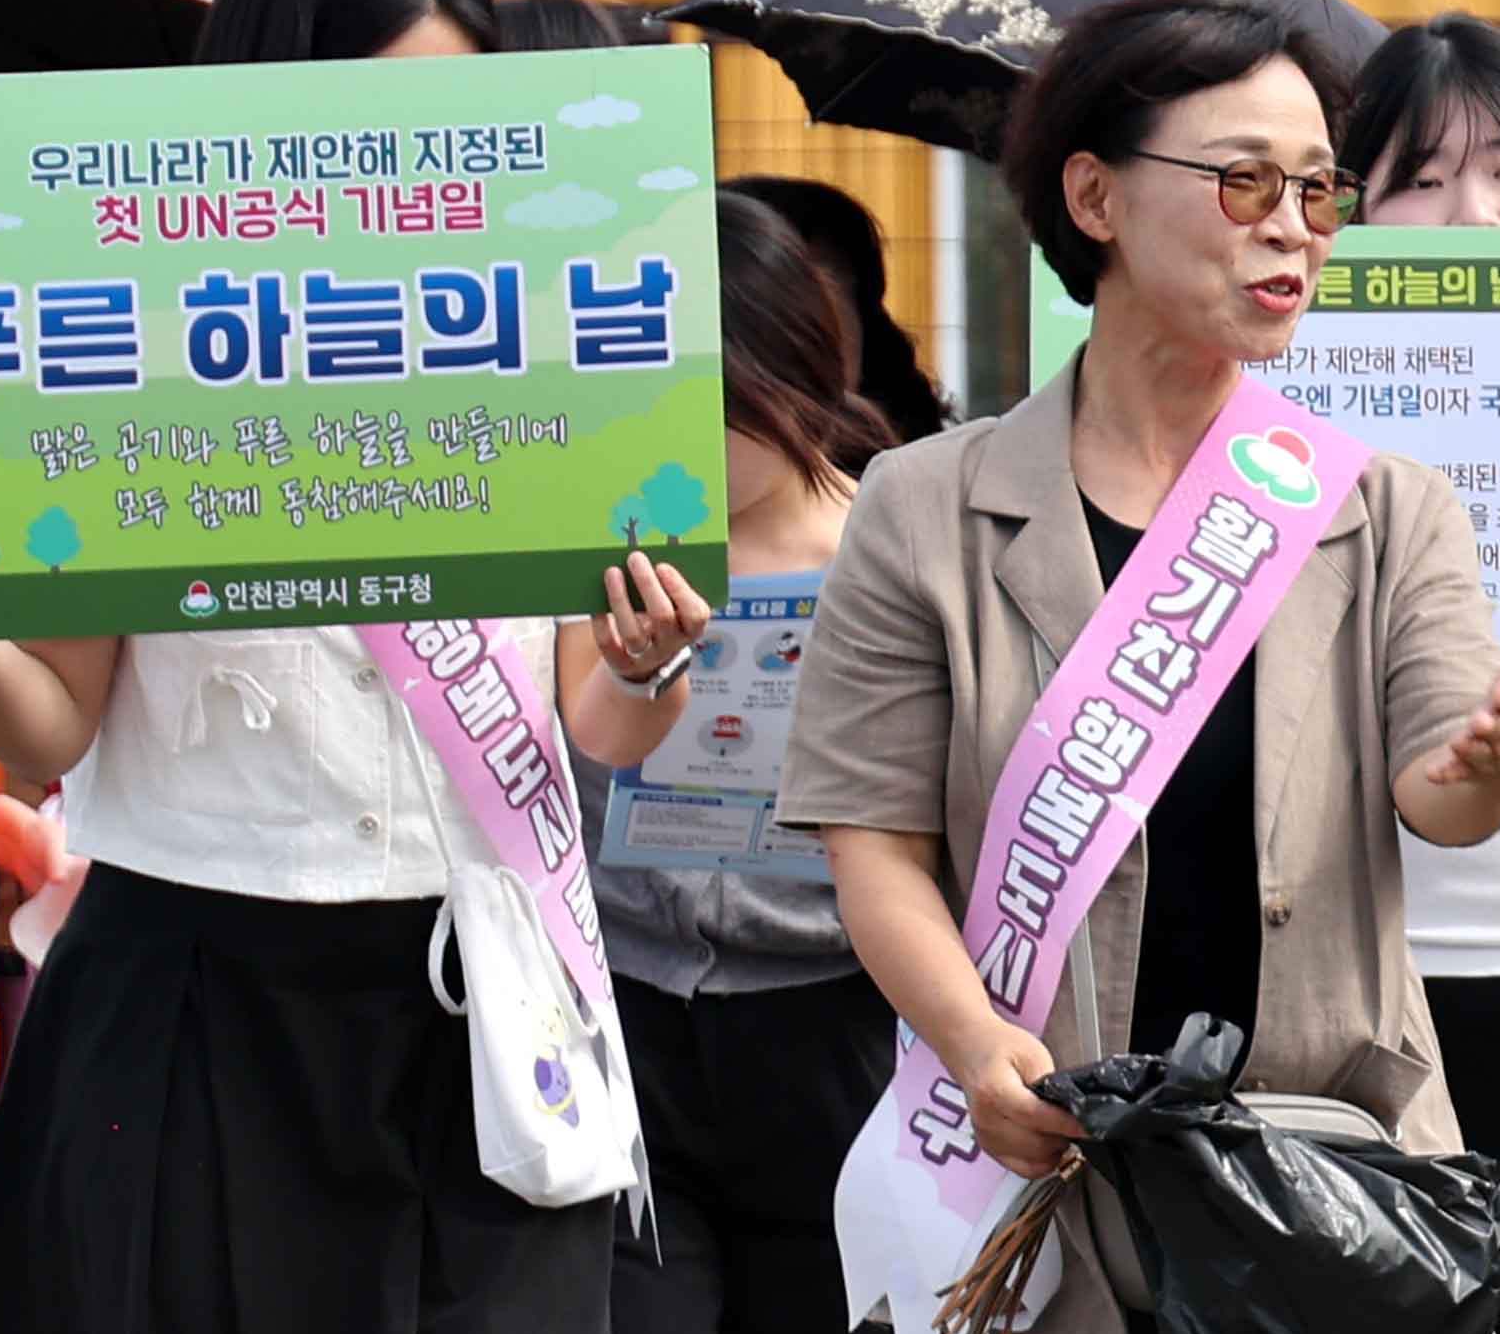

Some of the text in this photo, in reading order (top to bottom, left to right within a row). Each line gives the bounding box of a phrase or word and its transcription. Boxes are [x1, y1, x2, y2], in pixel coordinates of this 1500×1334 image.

[30, 123, 546, 190] 우리나라가 제안해 지정된
[95, 181, 485, 246] 첫 UN공식 기념일
[1366, 265, 1476, 306] 하늘의
[183, 264, 524, 383] 하늘의
[567, 259, 675, 368] 날
[1325, 346, 1396, 374] 제안해
[1404, 345, 1474, 373] 채택된
[1342, 383, 1471, 417] 기념일이자
[31, 407, 567, 479] 맑은 공기와 푸른 하늘을 만들기에
[115, 475, 490, 530] 모두 함께 동참해주세요!
[224, 572, 433, 612] 인천광역시 동구청
[1108, 493, 1280, 715] 활기찬
[978, 695, 1154, 1015] 행복도시
